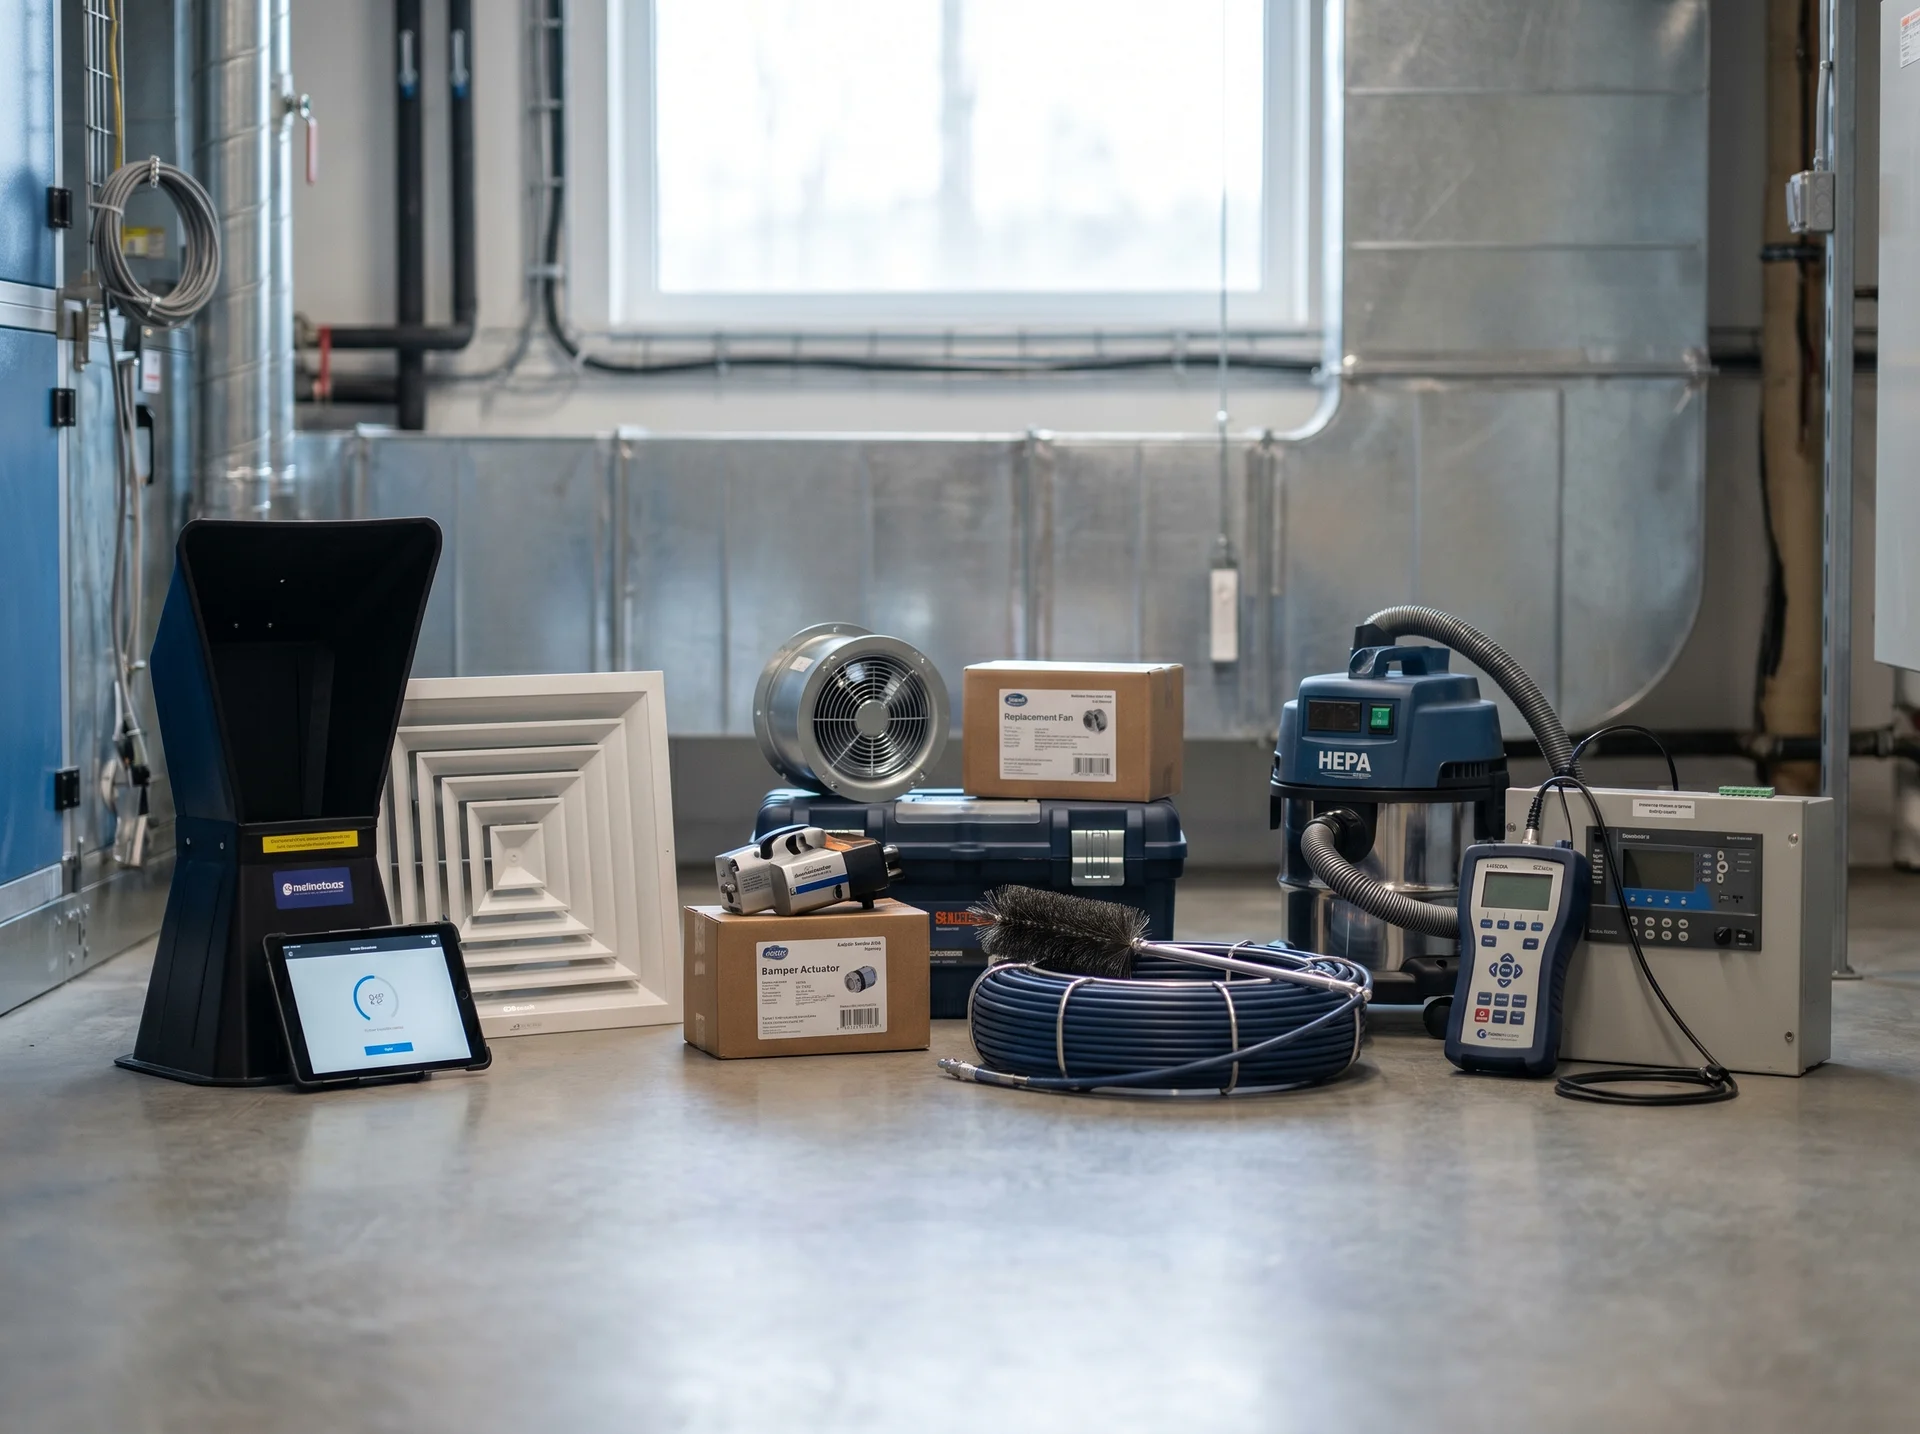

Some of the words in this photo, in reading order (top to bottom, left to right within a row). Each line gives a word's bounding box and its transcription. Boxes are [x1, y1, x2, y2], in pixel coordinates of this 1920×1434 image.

[1004, 713, 1057, 722] Replacement
[1318, 750, 1372, 772] HEPA
[761, 967, 798, 976] Bamper
[800, 964, 840, 974] Actuator
